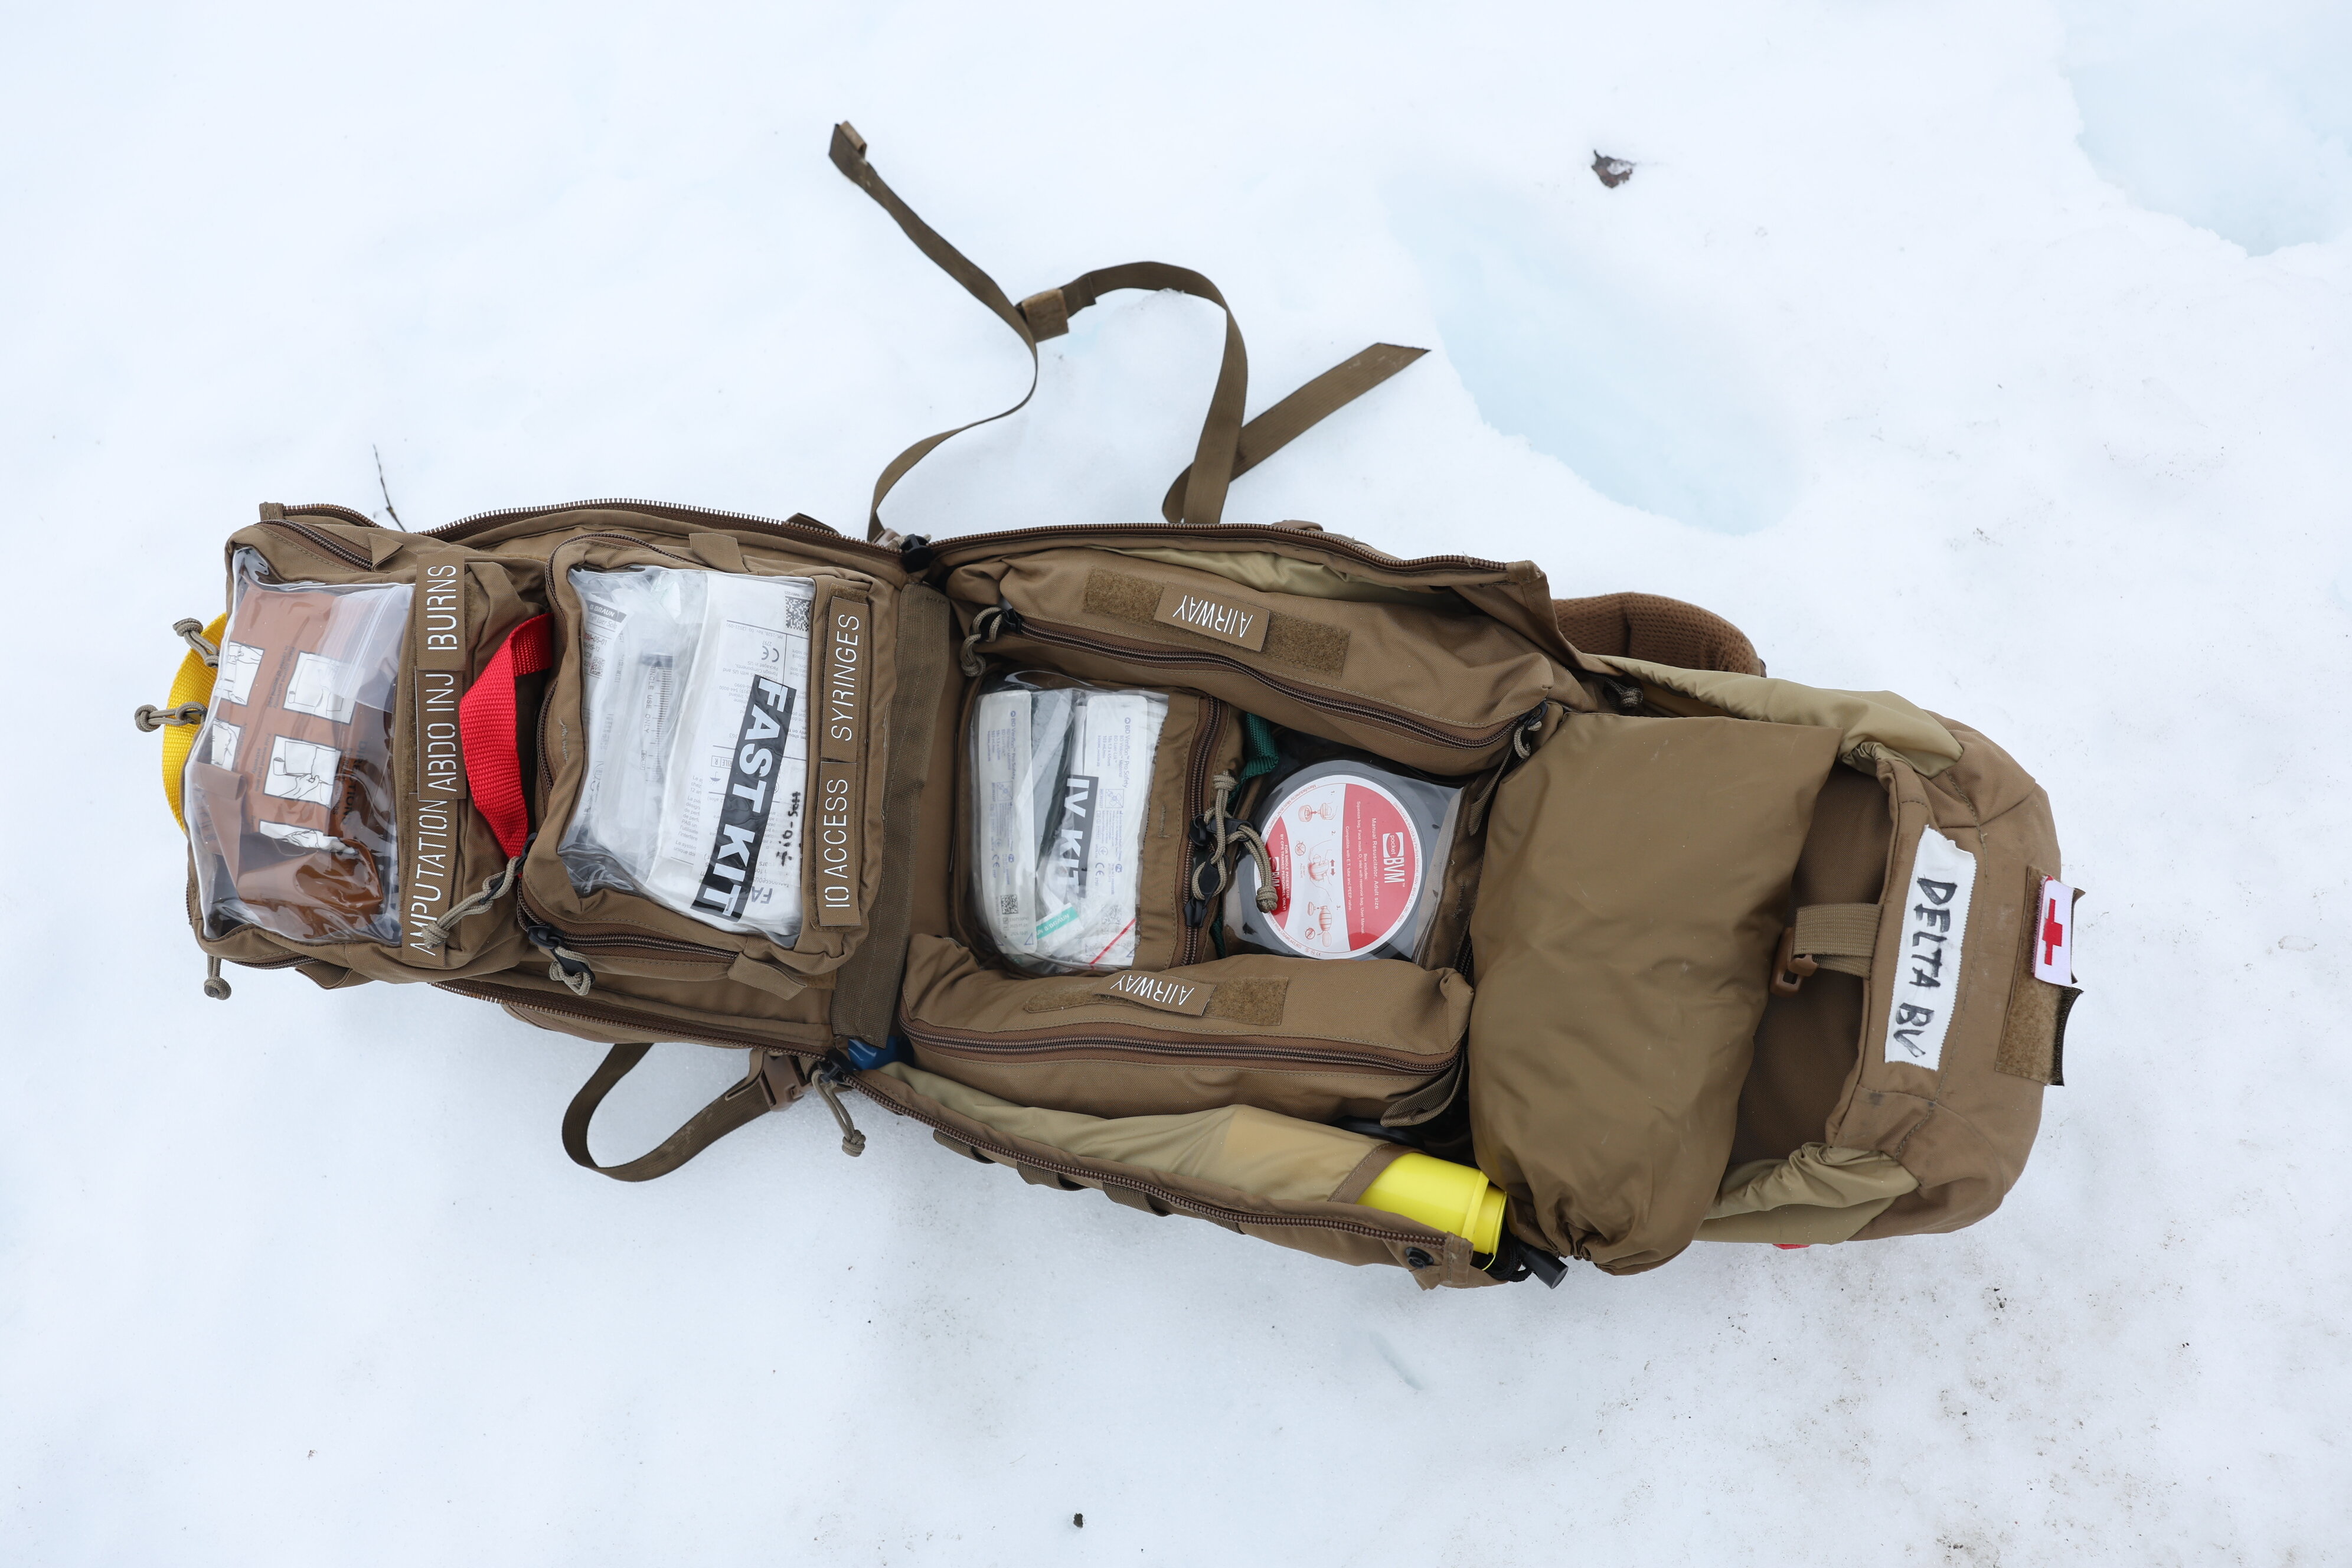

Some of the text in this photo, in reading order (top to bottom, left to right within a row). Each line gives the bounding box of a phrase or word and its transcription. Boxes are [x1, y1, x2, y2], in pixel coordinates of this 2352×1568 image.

[427, 566, 457, 649] BURNS
[1172, 595, 1253, 638] AIRWAY
[426, 674, 456, 791] ABDO INJ
[831, 615, 859, 741] SYRINGES
[1125, 725, 1131, 734] BD
[732, 677, 788, 813] FAST
[410, 801, 447, 956] AMPUTATION
[703, 823, 756, 915] KIT
[824, 780, 850, 907] IO ACCESS
[1059, 778, 1090, 893] IV KIT
[751, 886, 773, 904] FA
[1110, 975, 1194, 1005] AIRWAY
[1894, 877, 1958, 1057] DELTA BV
